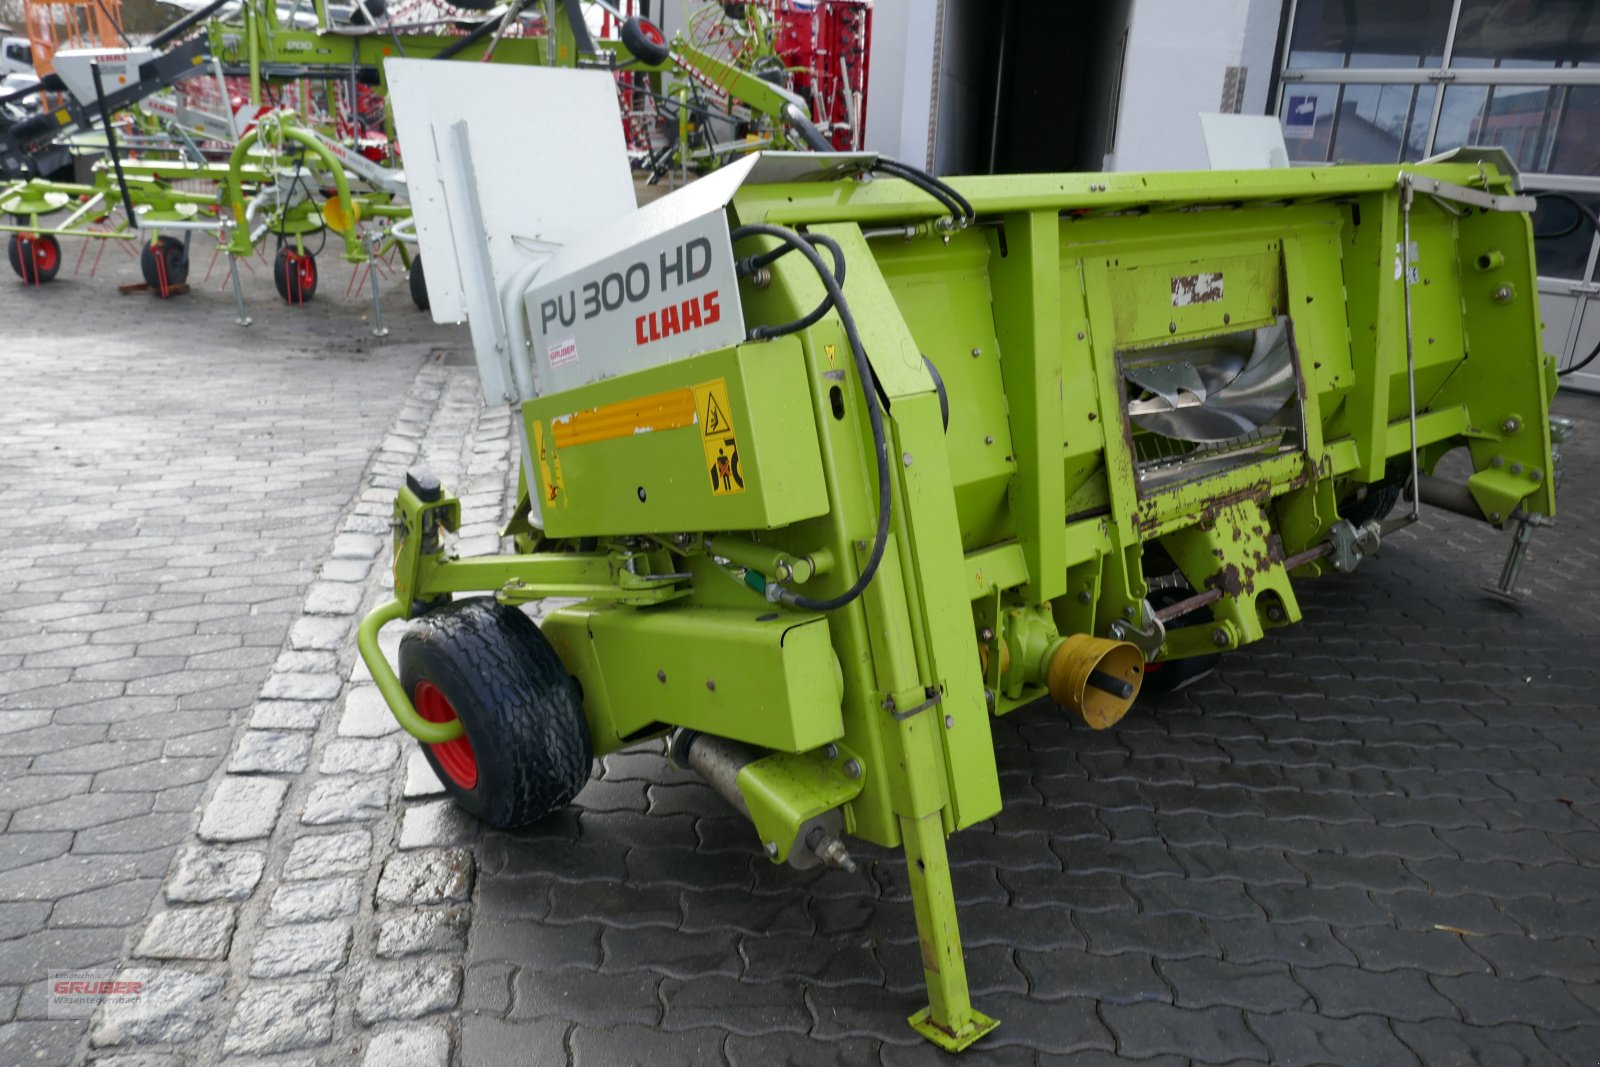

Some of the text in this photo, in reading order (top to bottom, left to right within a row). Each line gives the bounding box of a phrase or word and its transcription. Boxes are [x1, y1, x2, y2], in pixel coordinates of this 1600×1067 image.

[541, 237, 712, 335] PU 300 HD
[635, 290, 720, 346] CLAAS
[550, 344, 576, 360] GRUBER
